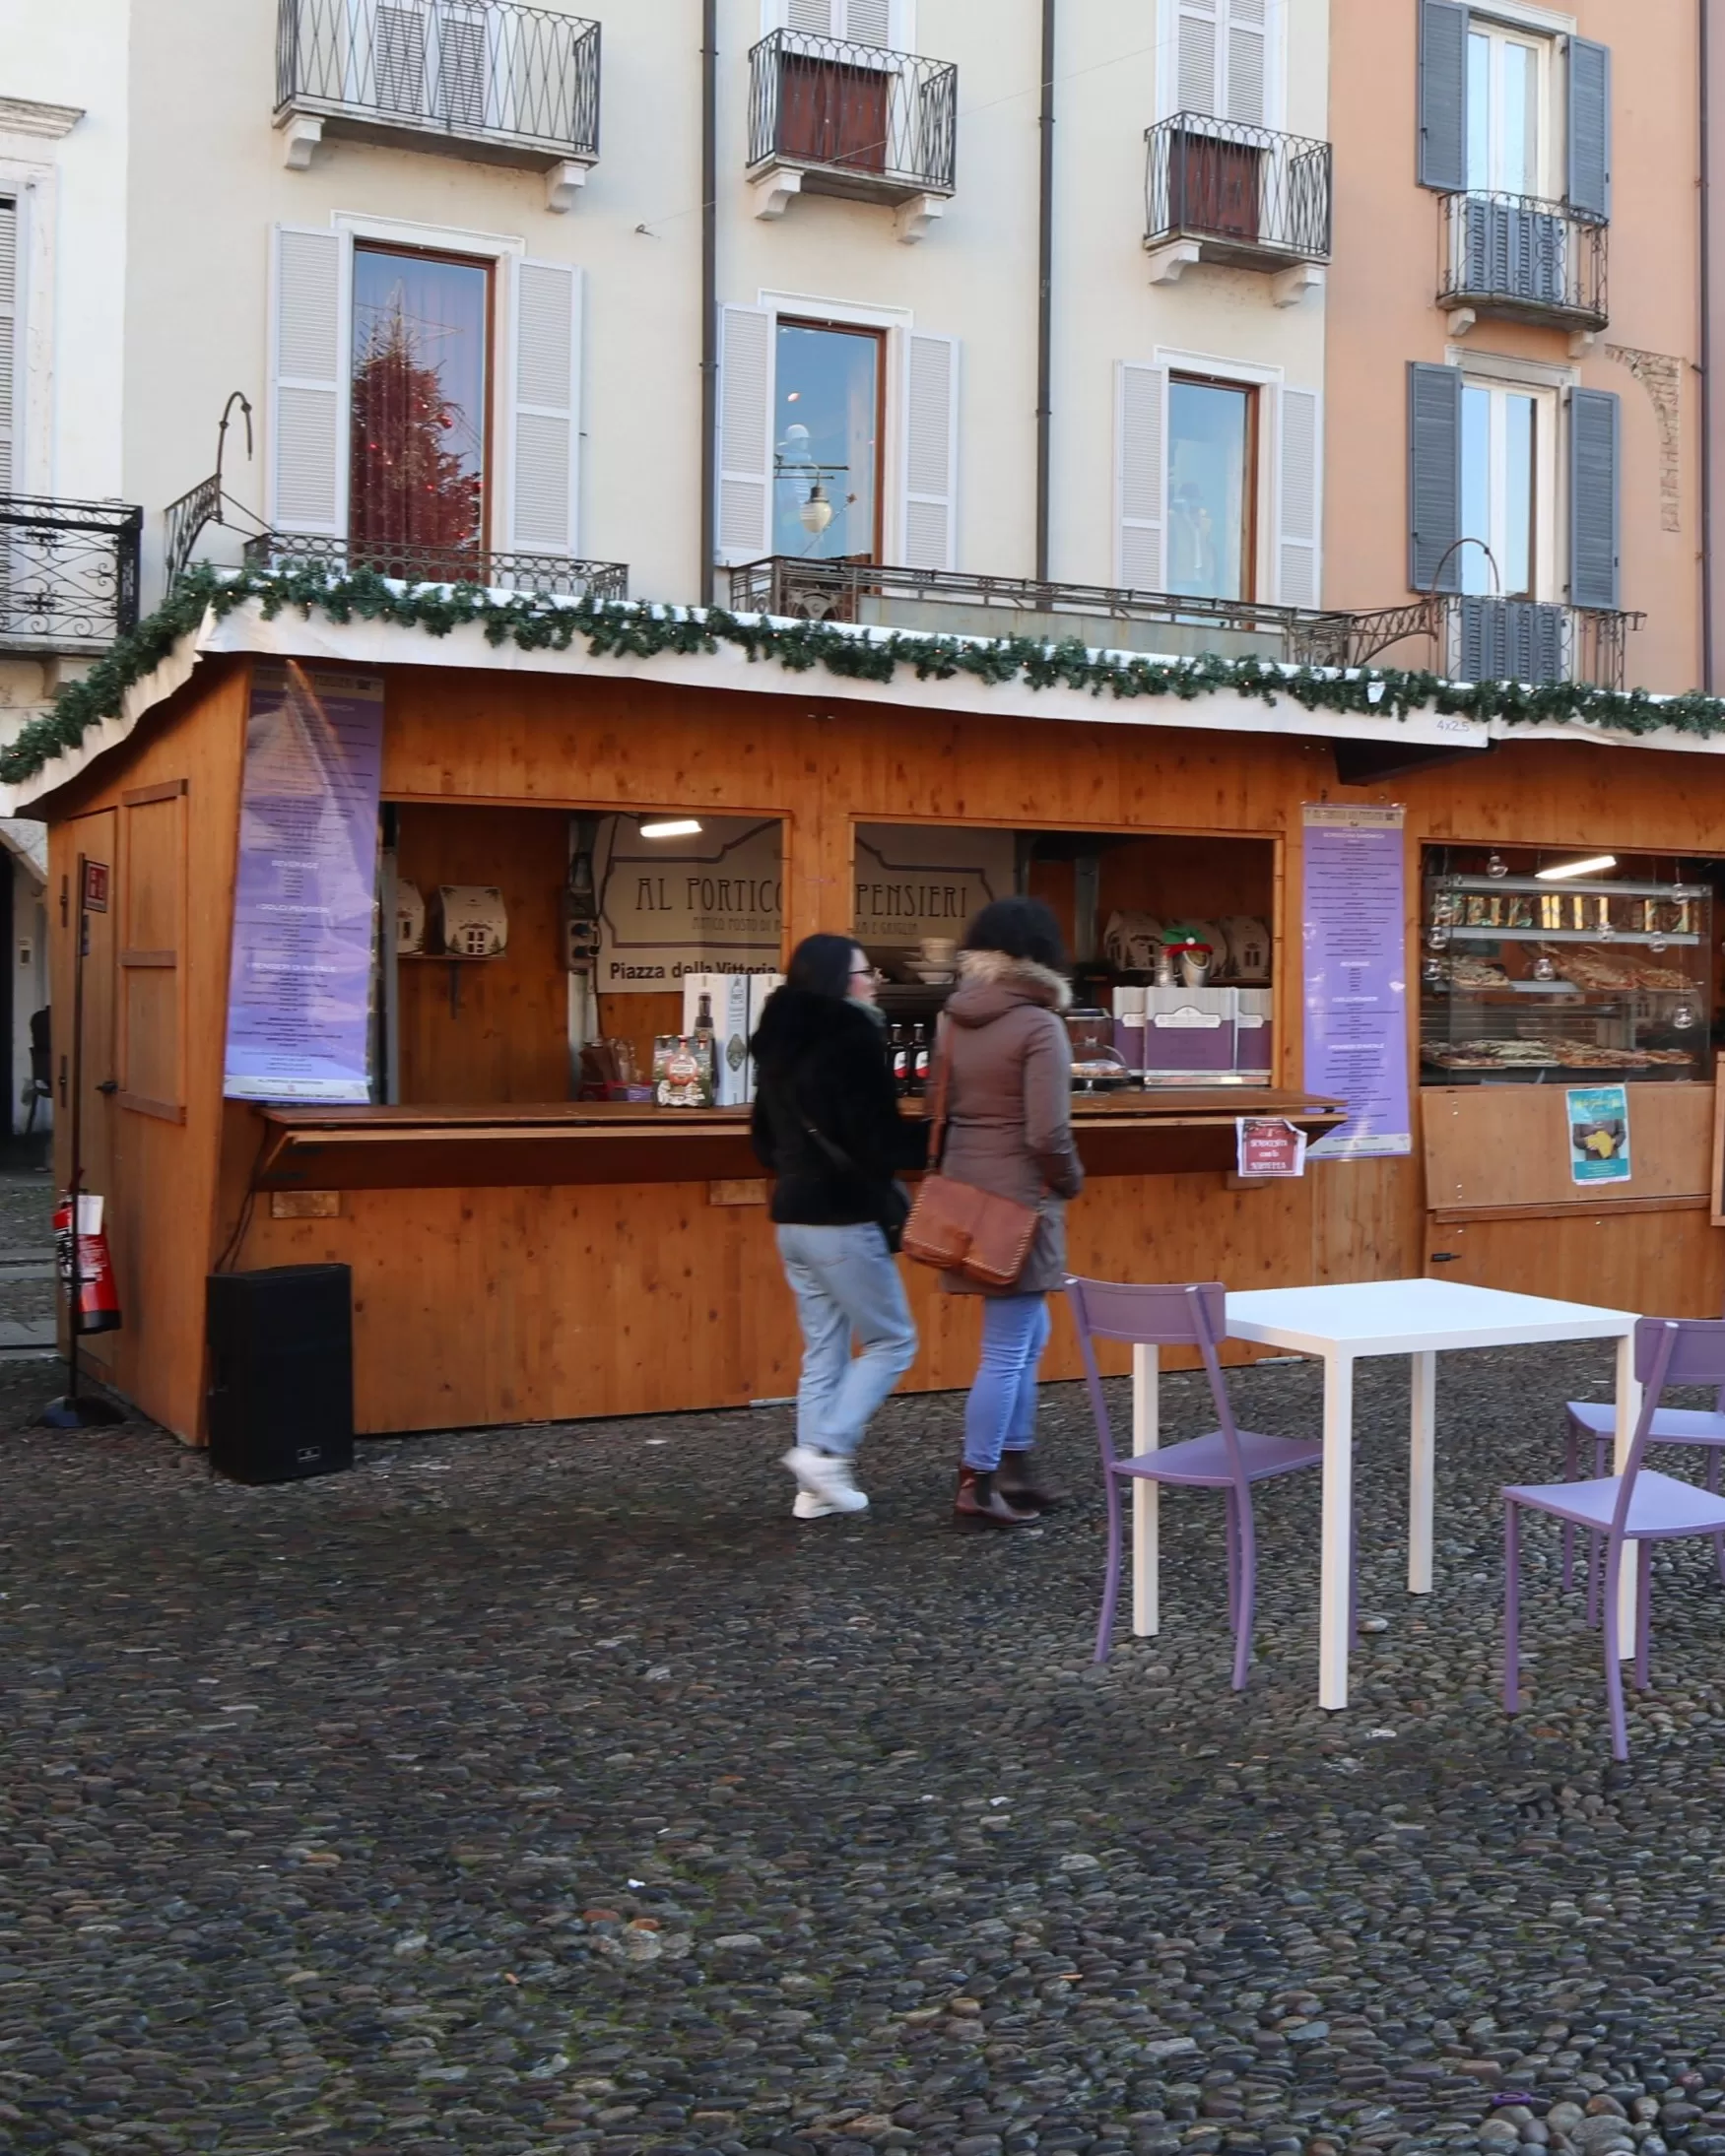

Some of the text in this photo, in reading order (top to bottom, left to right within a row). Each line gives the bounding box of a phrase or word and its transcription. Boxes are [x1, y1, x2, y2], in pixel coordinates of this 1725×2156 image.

[635, 878, 672, 910] AL
[855, 883, 967, 917] PENSIERI
[611, 962, 665, 979] Piazza
[672, 961, 712, 978] della
